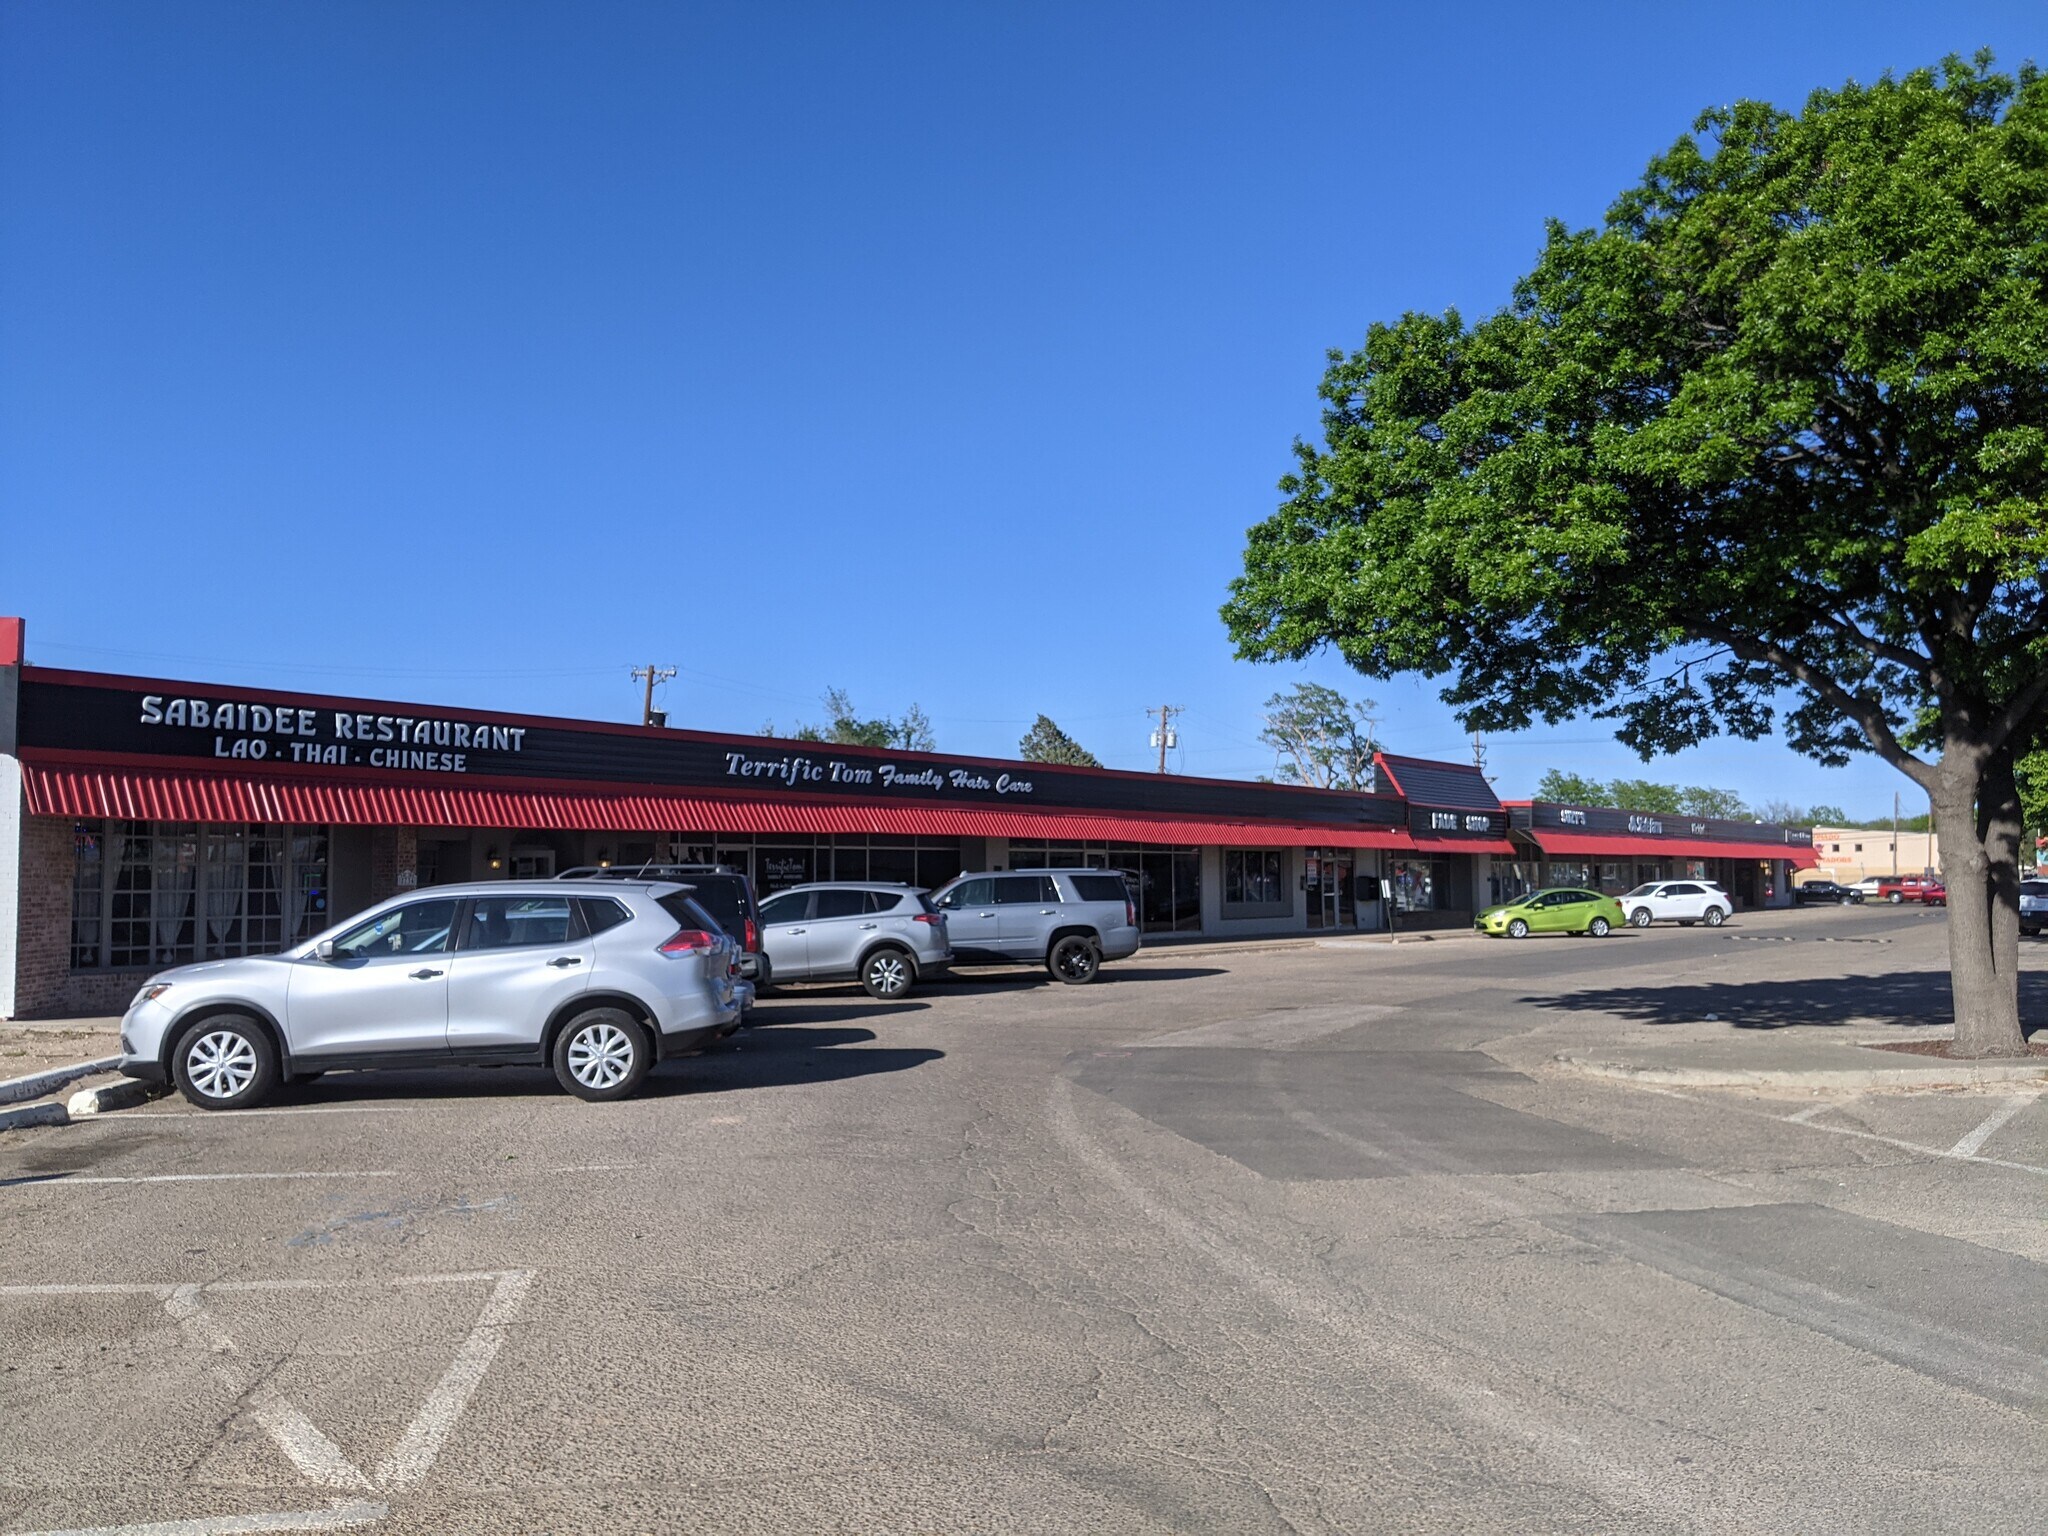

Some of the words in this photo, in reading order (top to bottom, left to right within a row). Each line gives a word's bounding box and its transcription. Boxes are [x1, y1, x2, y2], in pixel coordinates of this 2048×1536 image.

[140, 695, 316, 737] SABAIDEE
[335, 712, 526, 751] RESTAURANT
[214, 735, 268, 760] LAO
[290, 742, 347, 765] THAI
[369, 747, 467, 772] CHINESE
[725, 752, 823, 787] Terrific
[829, 761, 873, 784] Tom
[878, 764, 944, 791] Family
[949, 769, 991, 790] Hair
[995, 773, 1033, 794] Care
[1431, 812, 1458, 830] FADE
[1466, 815, 1490, 832] SHOP
